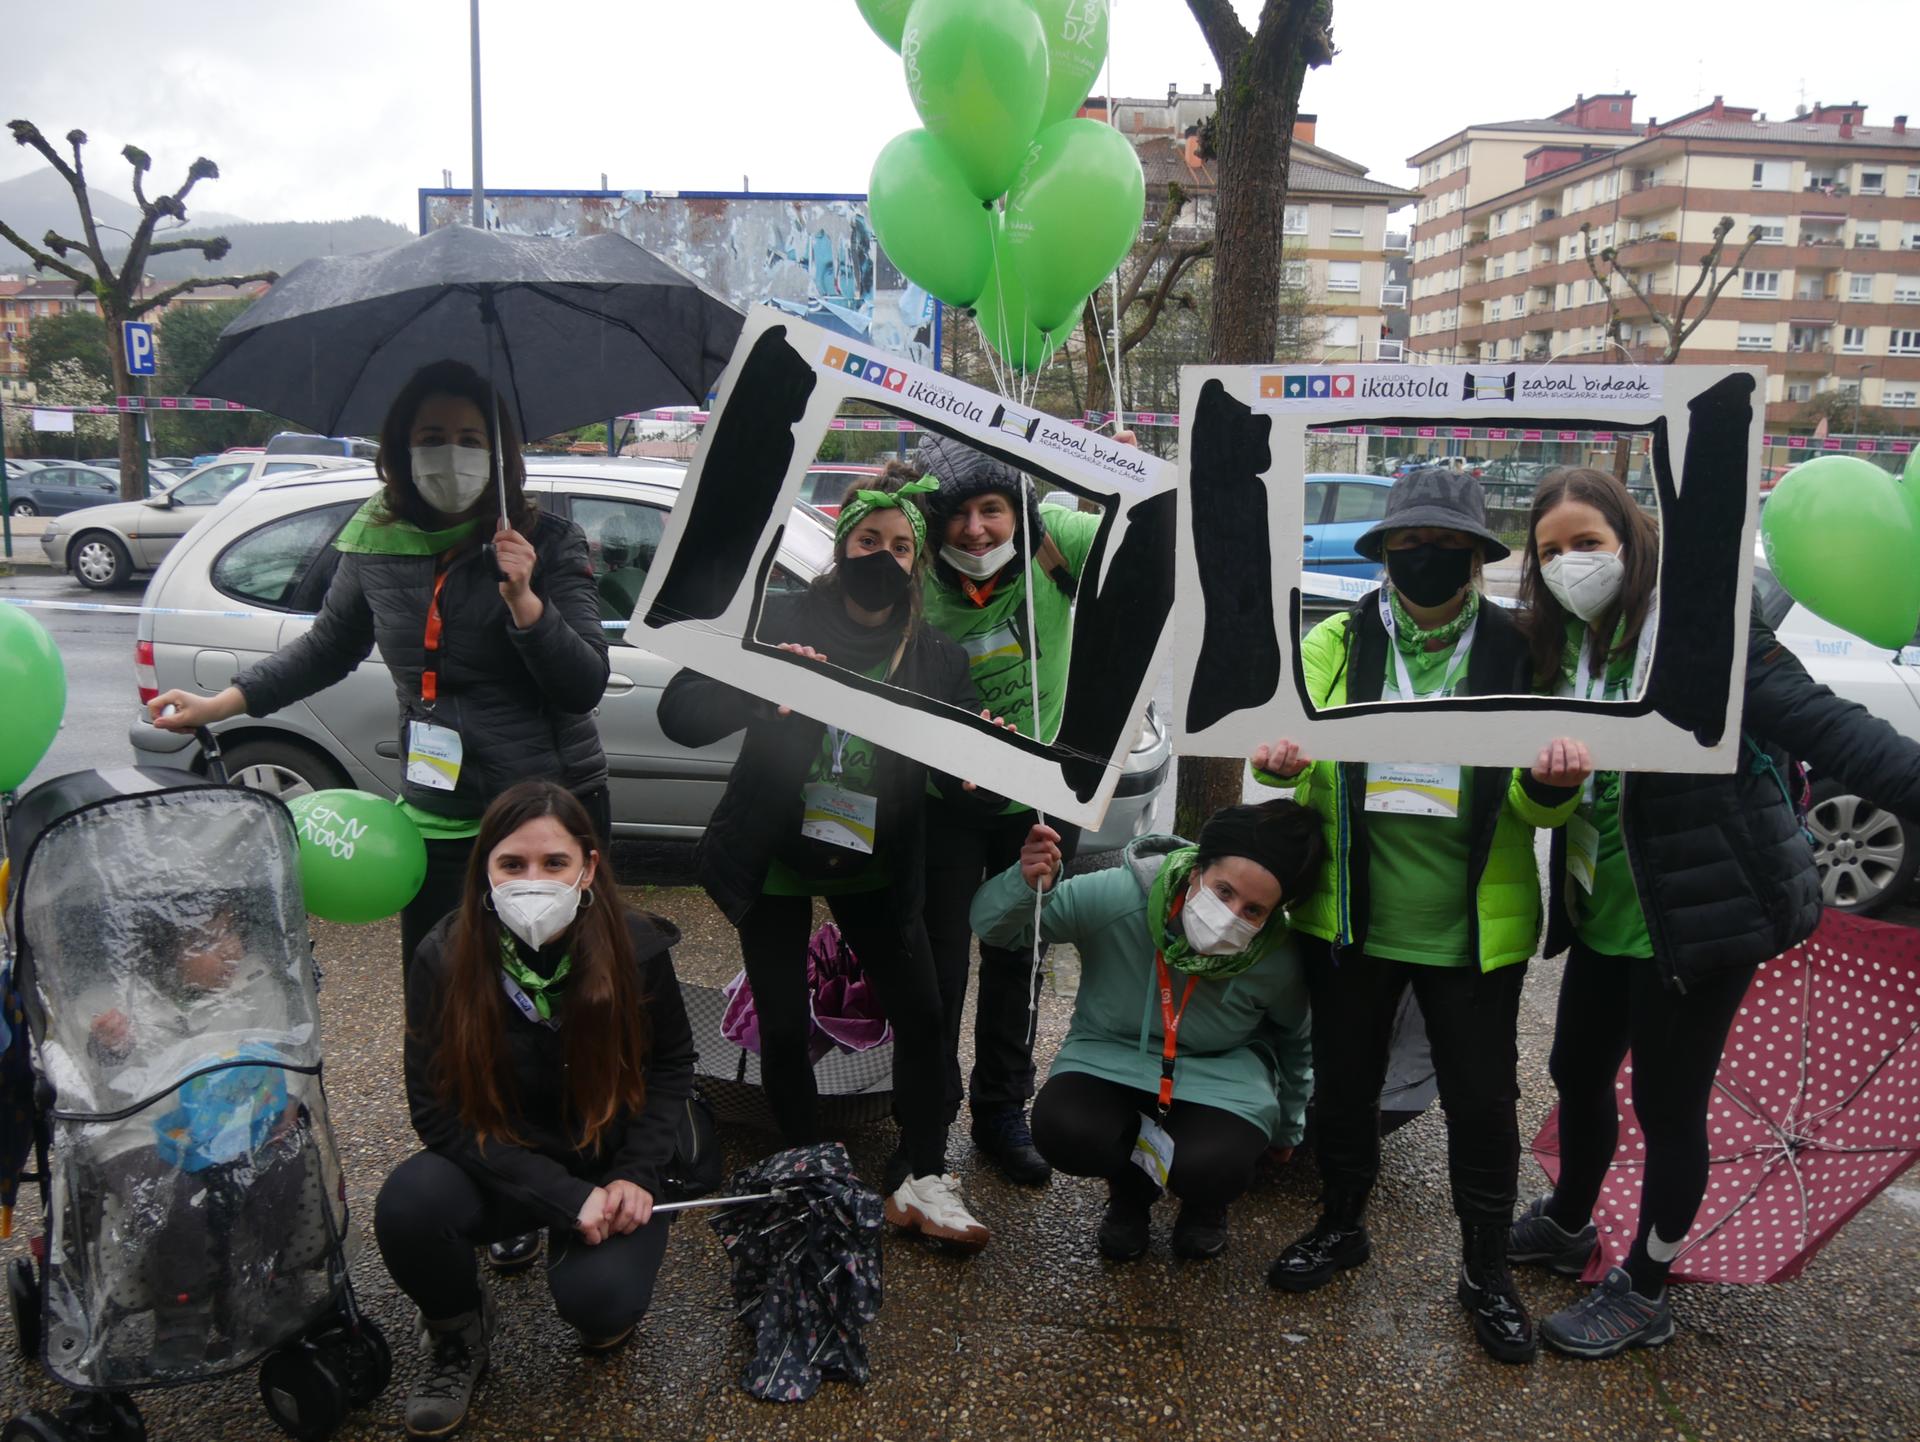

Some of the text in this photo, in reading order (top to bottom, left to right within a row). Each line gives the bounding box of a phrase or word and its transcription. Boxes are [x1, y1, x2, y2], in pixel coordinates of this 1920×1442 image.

[131, 328, 150, 369] P
[1361, 377, 1449, 398] ikastola
[1376, 374, 1410, 382] LAUDIO
[1522, 374, 1650, 391] zabal bideak
[924, 382, 953, 397] LAUDIO
[907, 380, 983, 423] ikastola
[1041, 428, 1147, 476] zabal bideak
